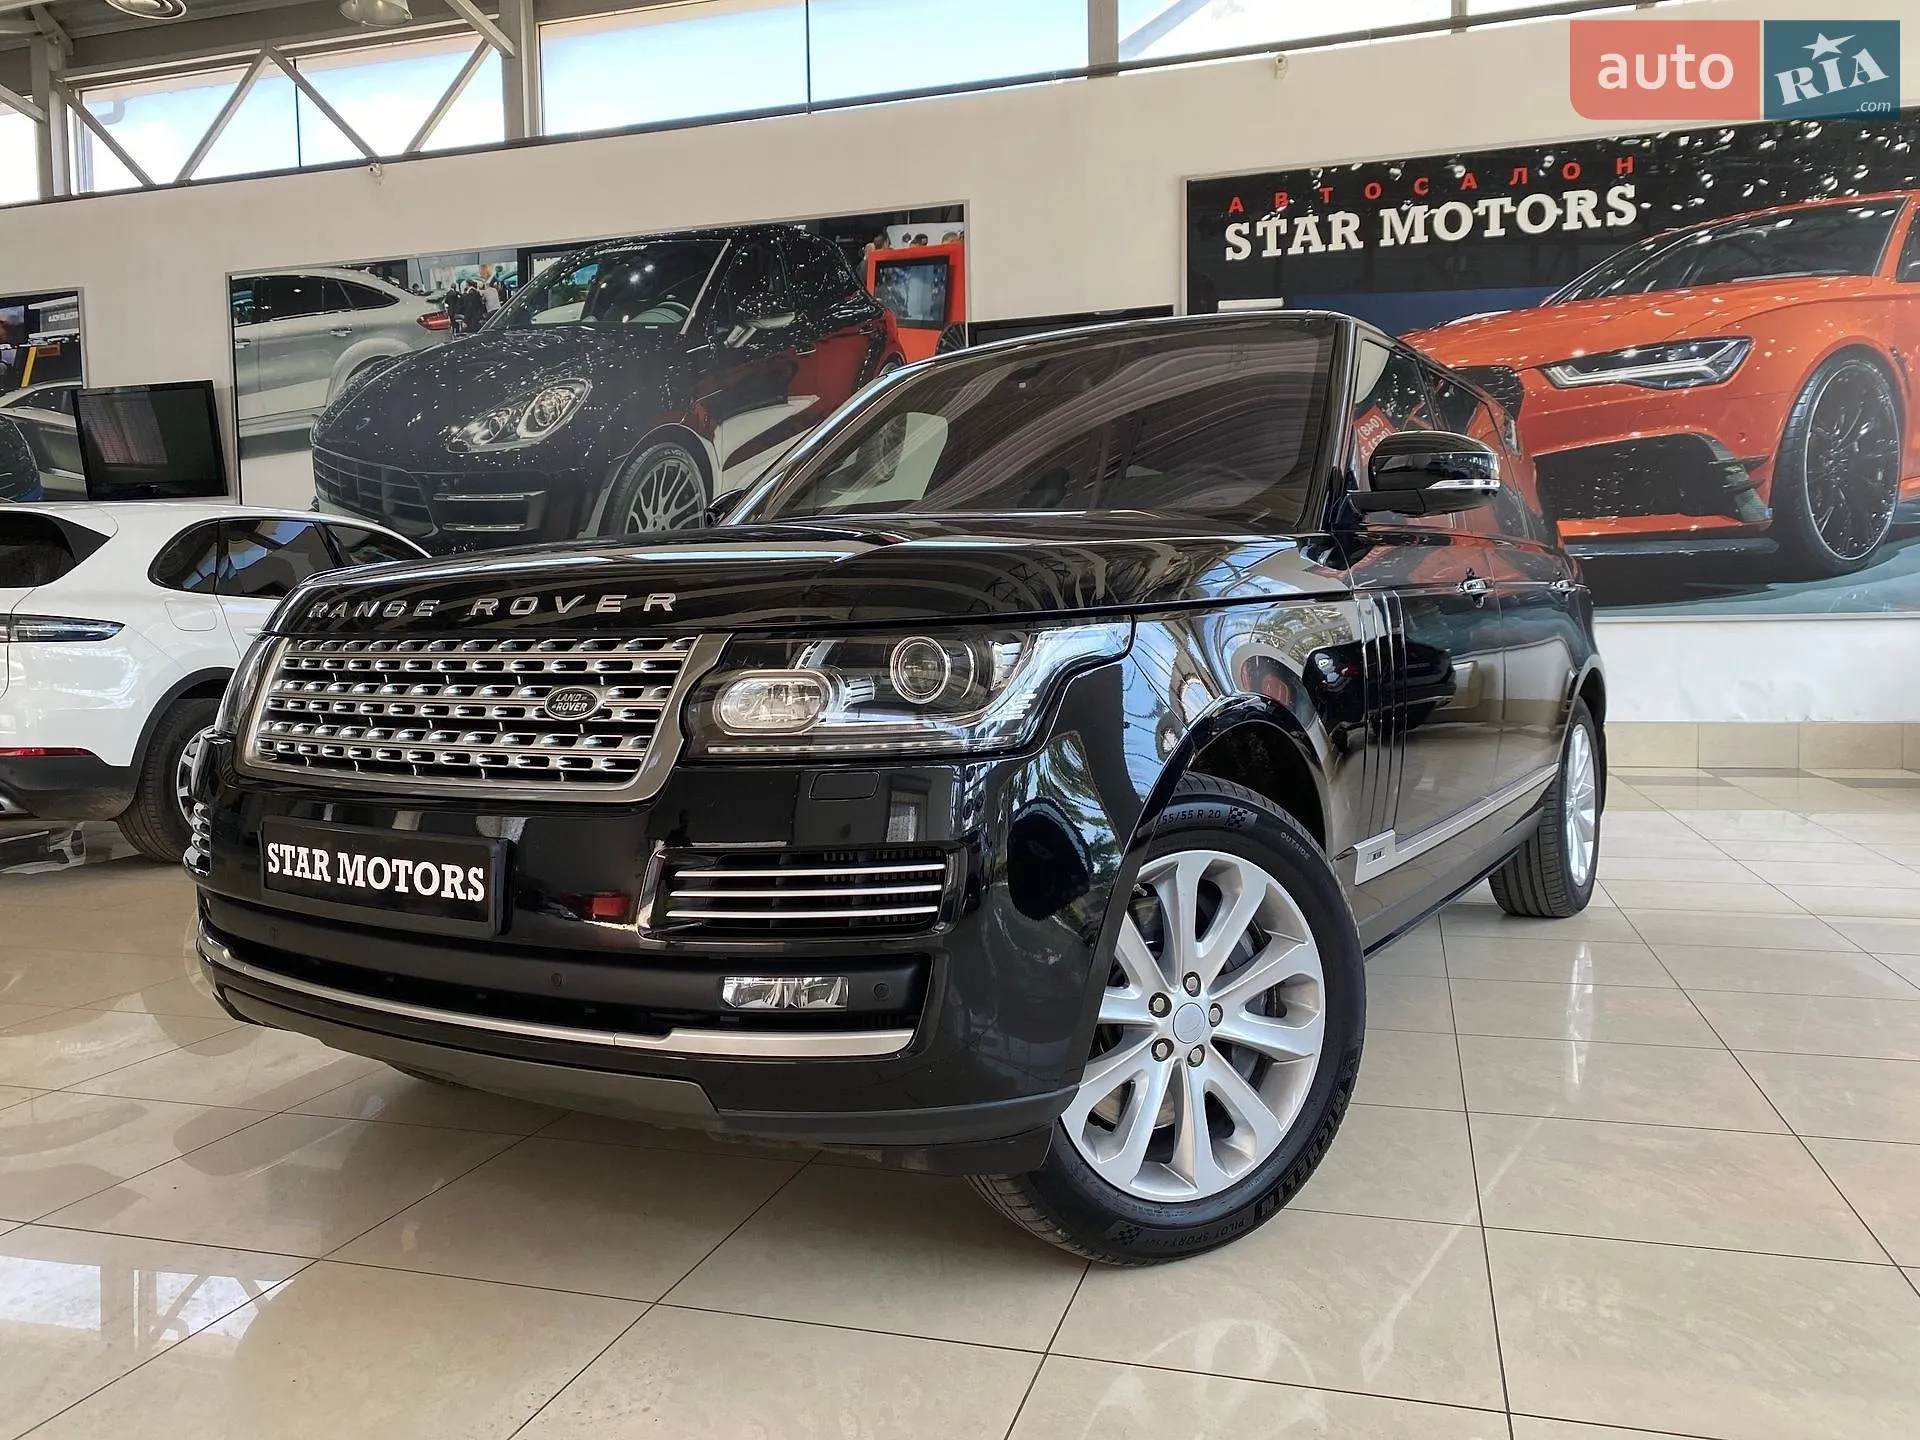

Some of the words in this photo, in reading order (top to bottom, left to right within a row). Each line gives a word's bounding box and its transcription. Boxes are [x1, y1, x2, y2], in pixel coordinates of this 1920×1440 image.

[1224, 210, 1365, 261] STAR
[1378, 183, 1638, 248] MOTORS
[305, 599, 441, 619] RANGE
[468, 592, 677, 617] ROVER
[555, 702, 588, 712] ROVER
[556, 693, 581, 702] LAND
[1161, 808, 1194, 825] 55/55
[1208, 809, 1221, 819] 20
[267, 842, 331, 882] STAR
[336, 851, 485, 902] MOTORS
[1260, 1086, 1347, 1218] MICHELIN
